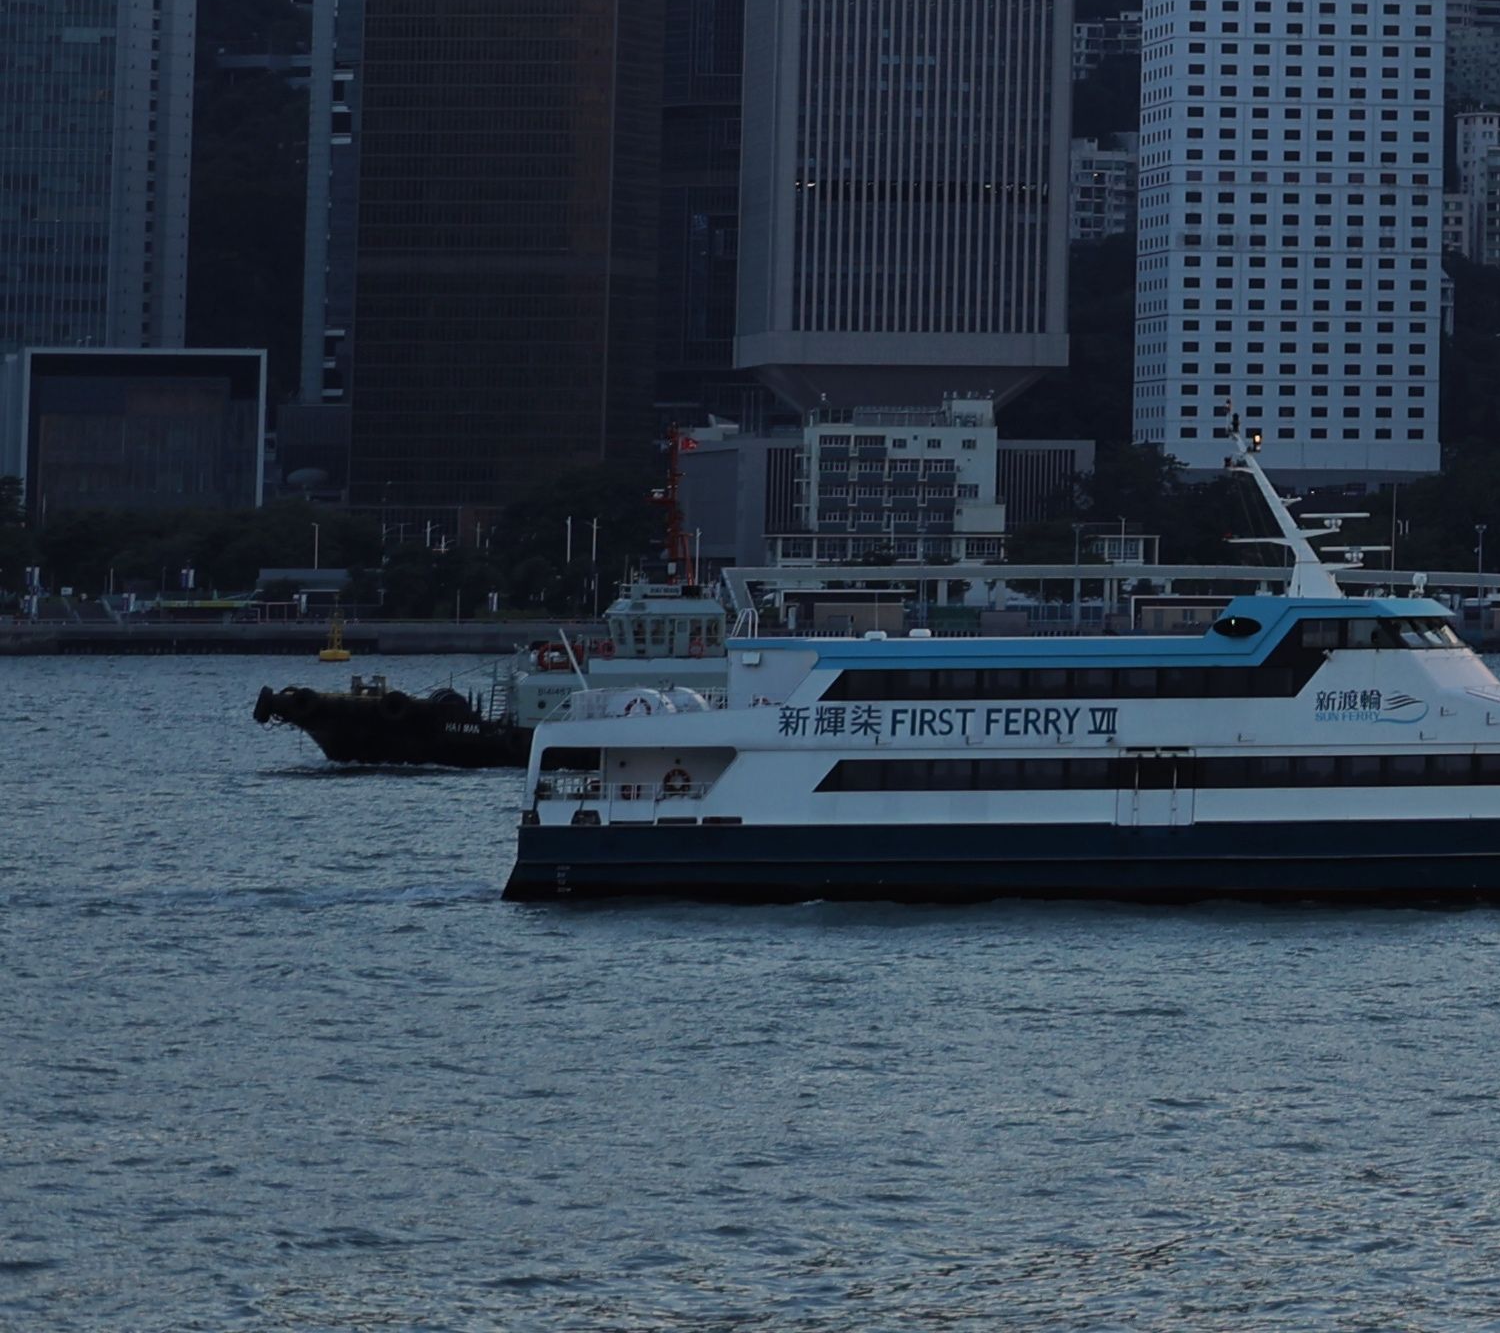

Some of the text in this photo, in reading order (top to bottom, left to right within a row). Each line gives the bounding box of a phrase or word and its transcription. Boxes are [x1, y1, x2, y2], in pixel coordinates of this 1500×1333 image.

[1315, 689, 1382, 711] 新渡輪
[779, 705, 1119, 737] 新輝柒 FIRST FERRY VII
[1315, 712, 1380, 722] SUN FERRY
